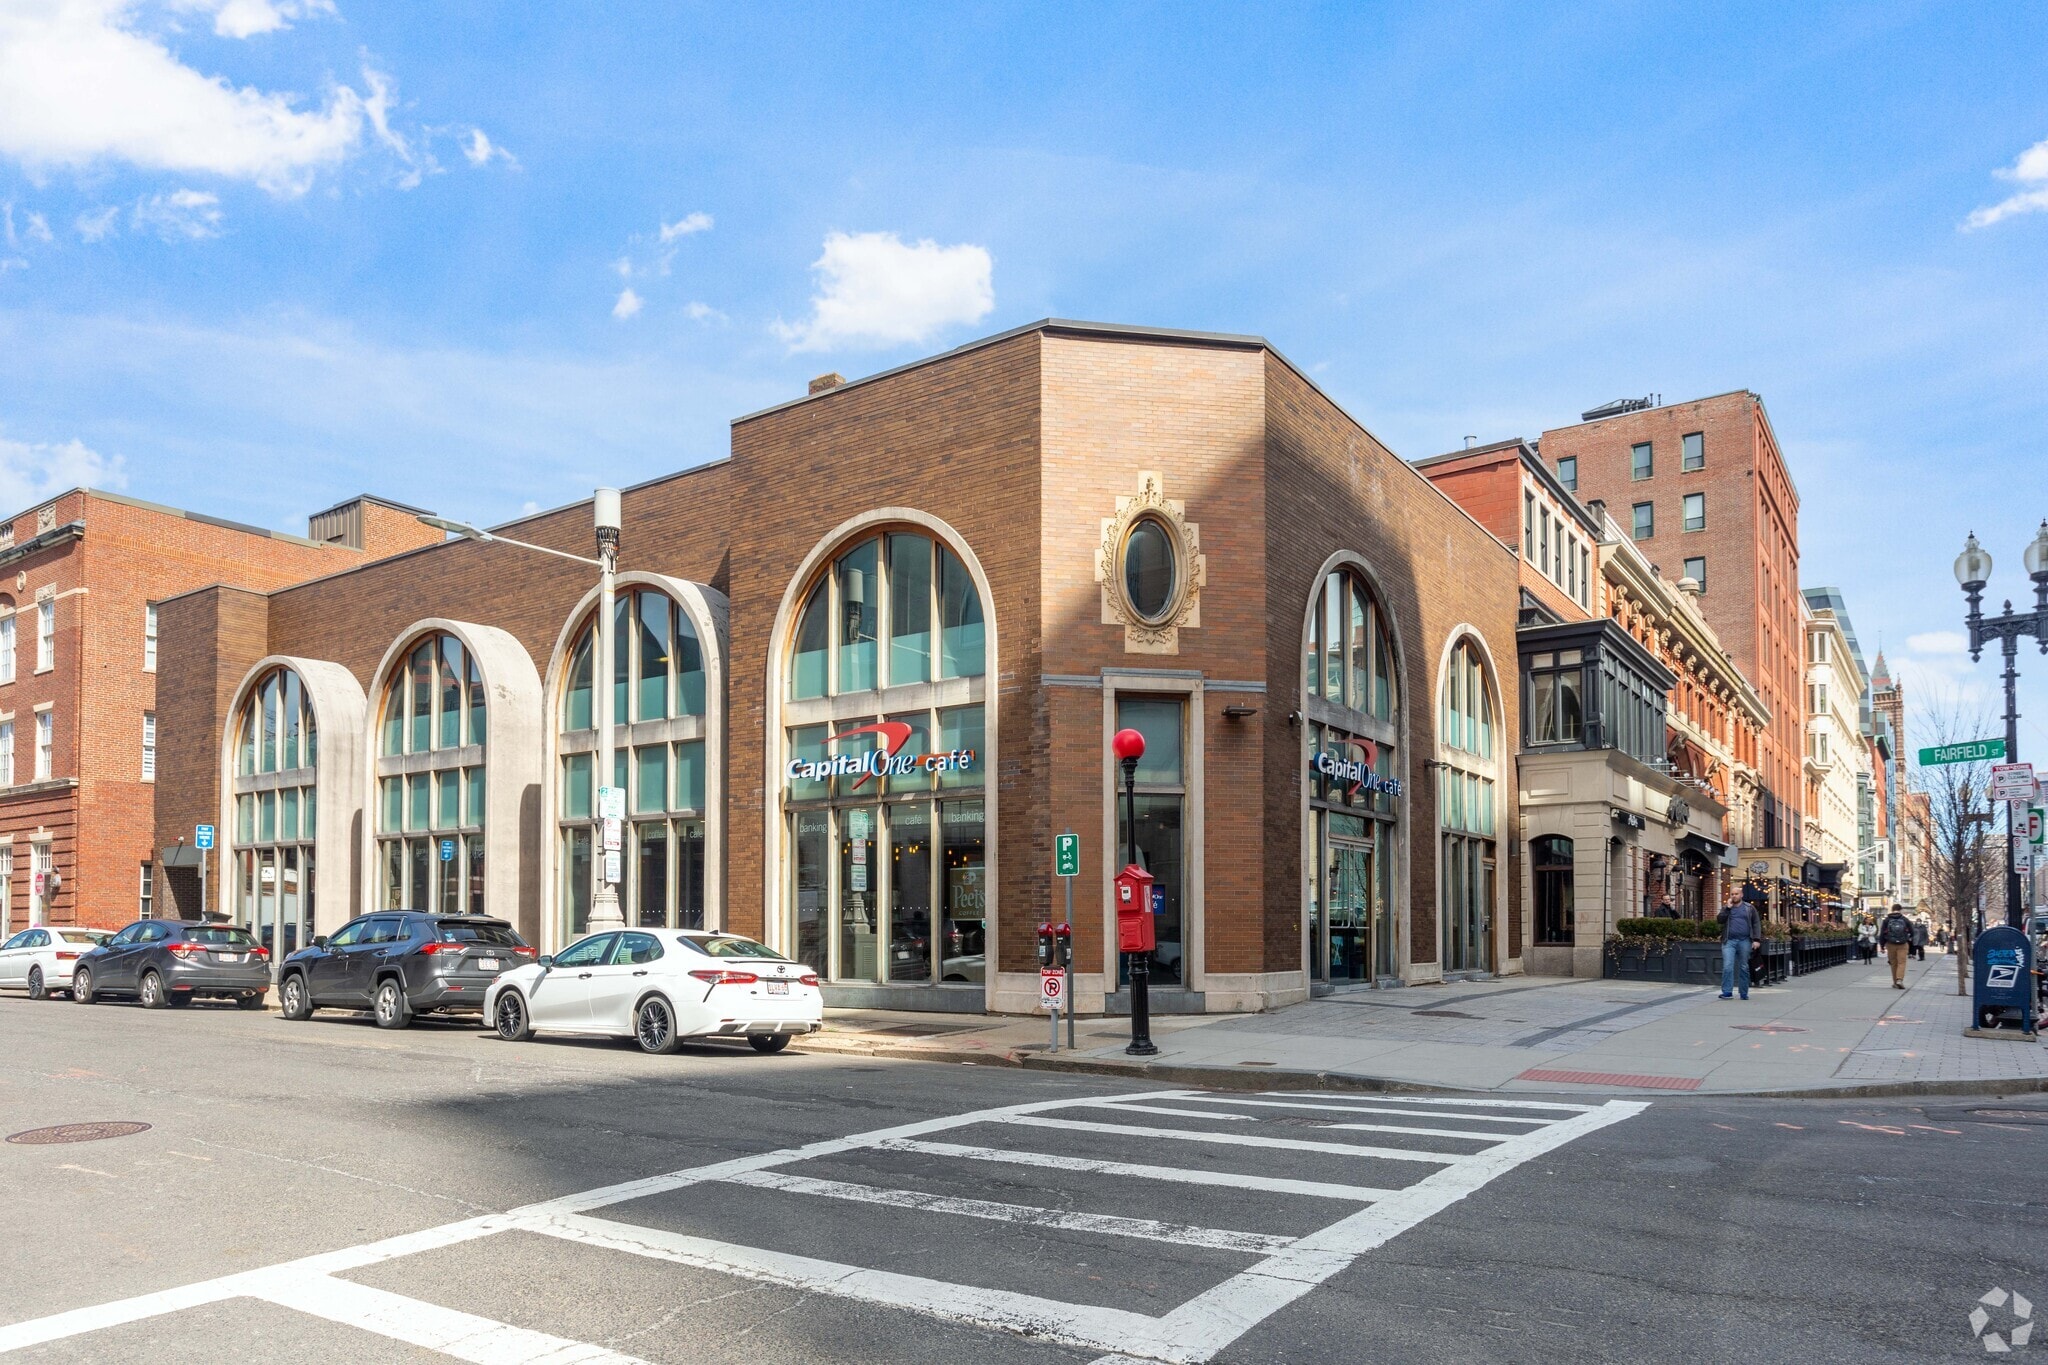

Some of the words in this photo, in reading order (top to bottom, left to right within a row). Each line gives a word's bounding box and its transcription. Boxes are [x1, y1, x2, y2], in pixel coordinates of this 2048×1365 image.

[1934, 744, 1987, 762] FAIRFIELD
[1991, 748, 1999, 756] ST
[786, 752, 868, 781] Capital
[870, 749, 916, 777] One
[925, 749, 969, 771] café
[1318, 752, 1362, 781] Capital
[1362, 764, 1381, 791] One
[1384, 779, 1401, 797] café
[905, 814, 922, 825] café
[951, 810, 984, 822] banking
[800, 822, 827, 834] banking
[2029, 817, 2038, 837] F
[1062, 837, 1073, 851] P
